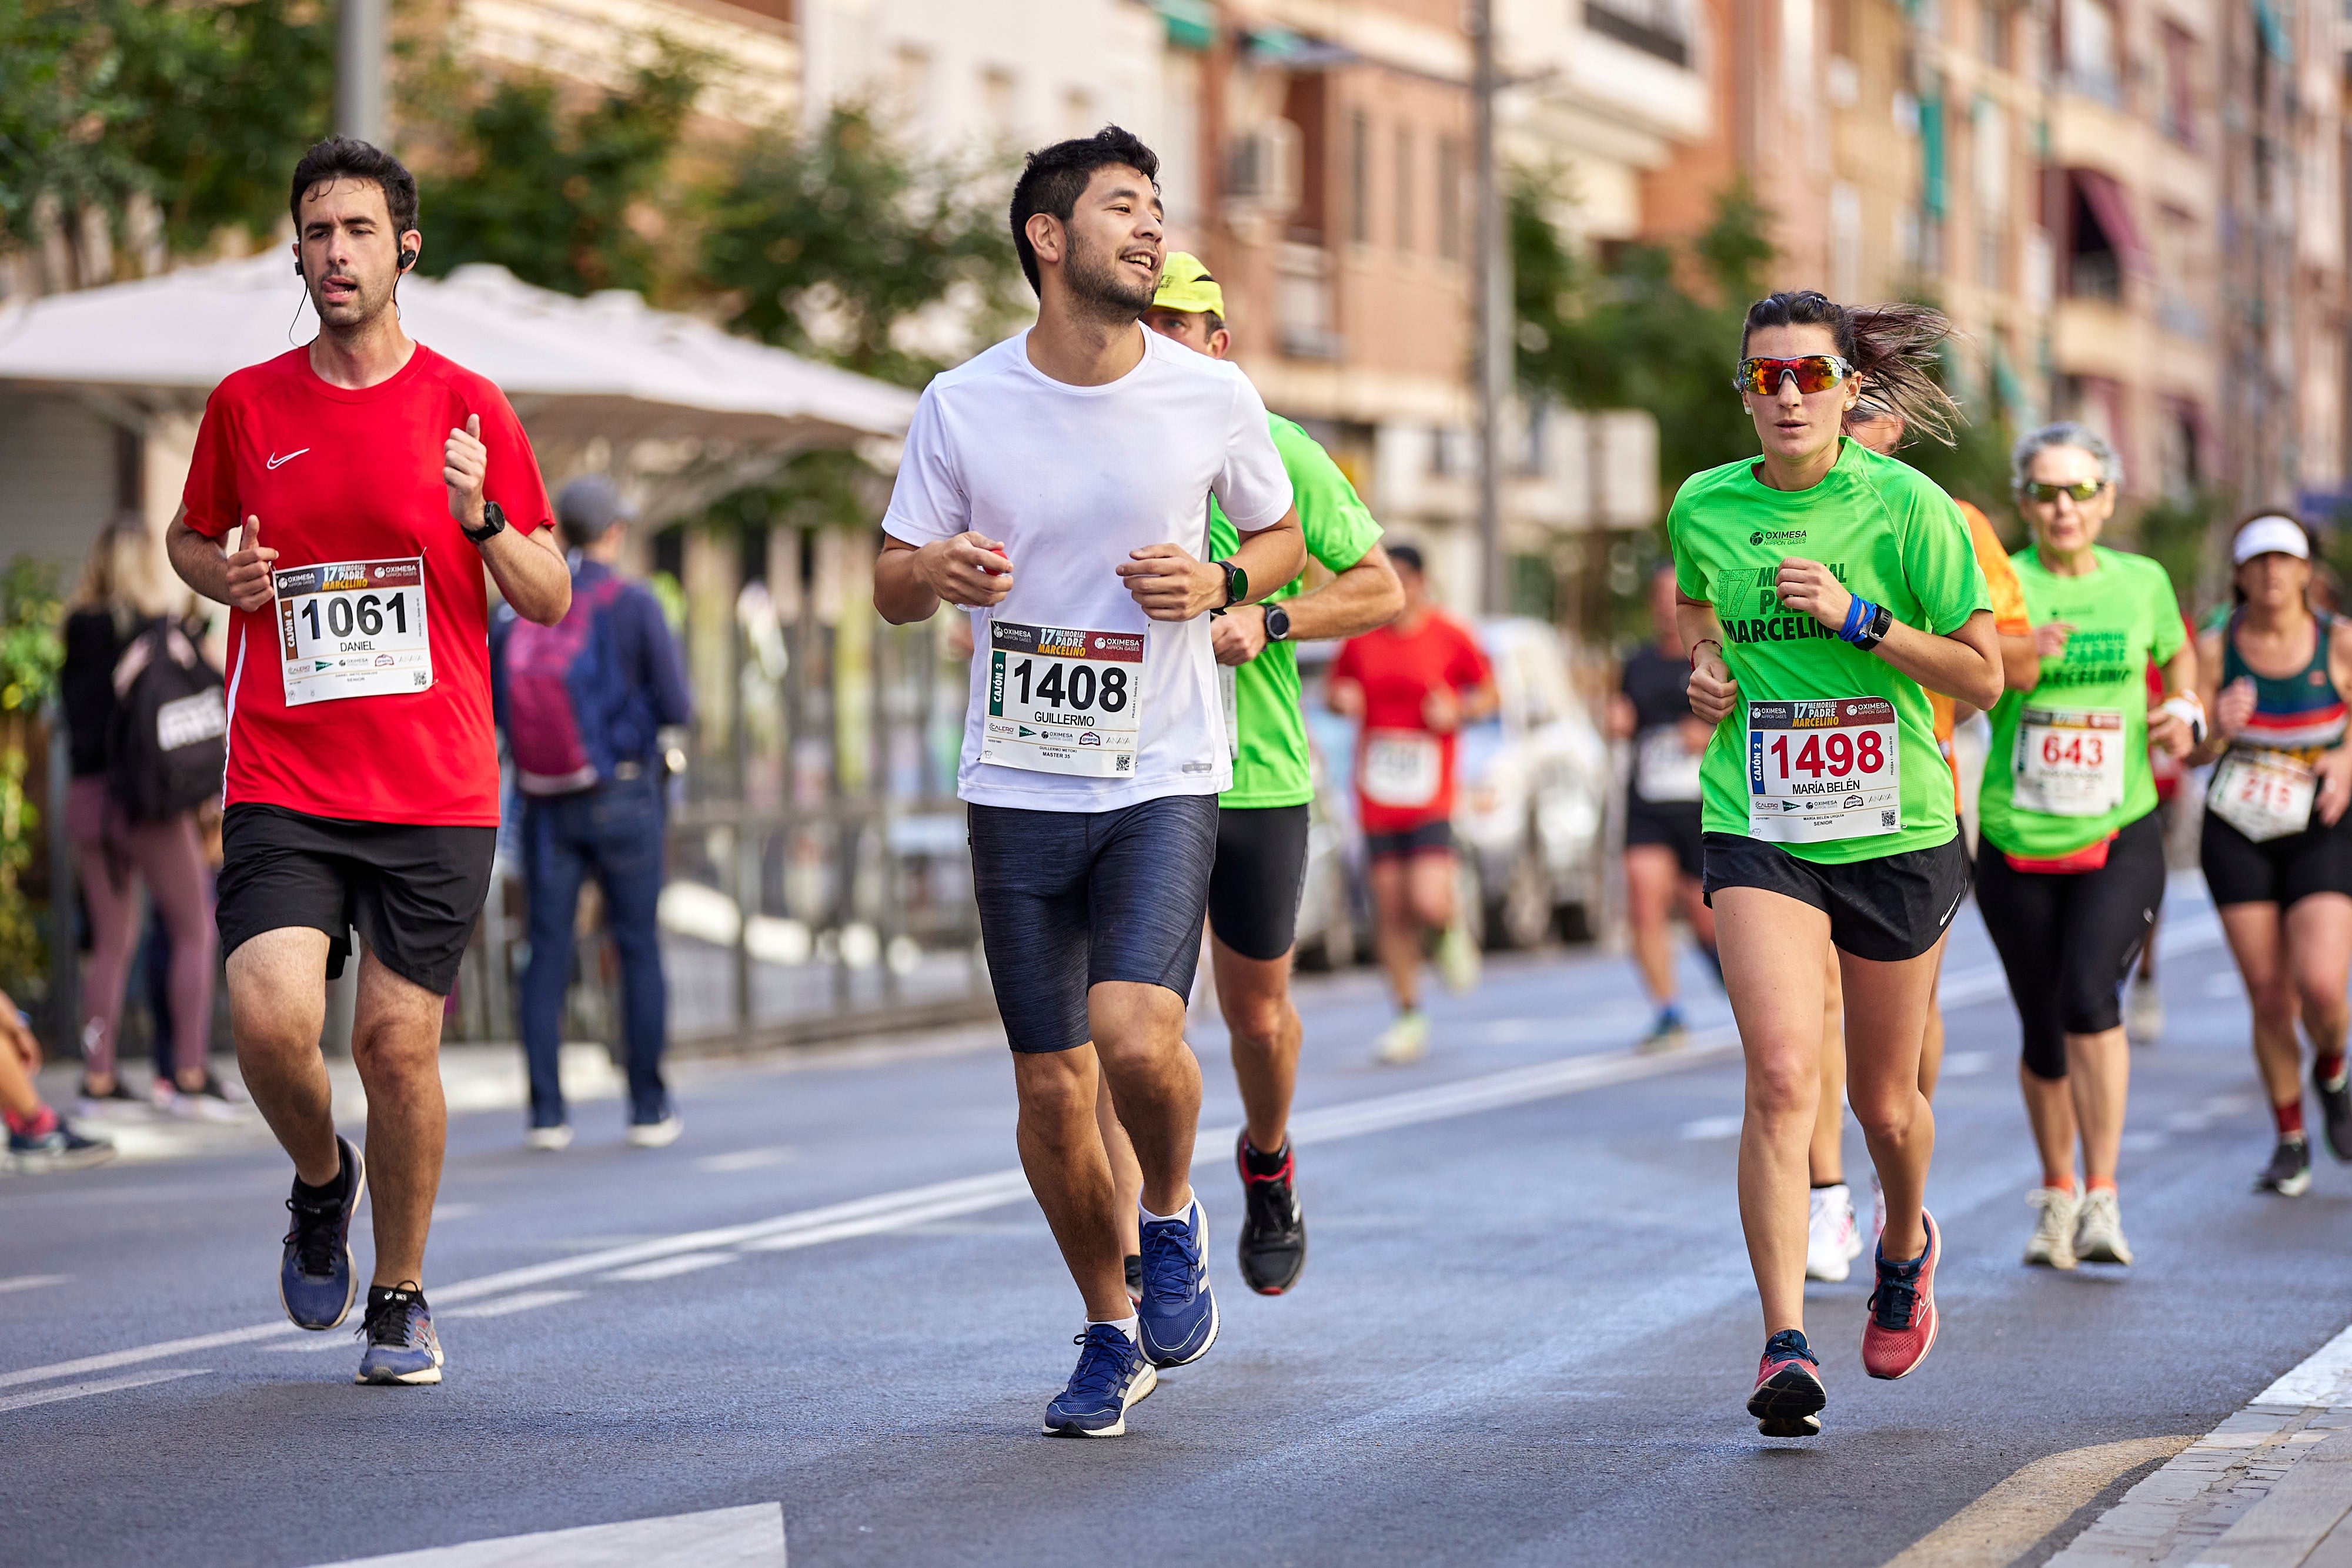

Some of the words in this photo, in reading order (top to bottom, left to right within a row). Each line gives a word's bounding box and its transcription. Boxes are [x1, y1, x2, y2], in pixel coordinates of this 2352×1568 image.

[1766, 530, 1806, 539] OXIMESA
[323, 566, 338, 582] 17
[338, 564, 366, 572] MEMORIAL
[385, 564, 417, 573] OXIMESA
[288, 573, 315, 583] OXIMESA
[339, 570, 365, 581] PADRE
[322, 578, 368, 591] MARCELINO
[1718, 569, 1759, 617] 17
[302, 592, 406, 640] 1061
[285, 619, 295, 647] CAJÓN
[1003, 628, 1031, 638] OXIMESA
[1721, 616, 1836, 643] MARCELIN
[1040, 628, 1057, 645] 17
[1055, 630, 1086, 638] MEMORIAL
[1055, 636, 1084, 647] PADRE
[1106, 638, 1140, 646] OXIMESA
[340, 641, 375, 652] DANIEL
[1037, 644, 1086, 657] MARCELINO
[993, 672, 1003, 703] CAJÓN
[1014, 658, 1127, 713] 1408
[1794, 703, 1808, 718] 17
[1858, 702, 1890, 710] OXIMESA
[1034, 711, 1095, 727] GUILLERMO
[1809, 708, 1836, 718] PADRE
[1792, 716, 1839, 727] MARCELINO
[991, 724, 1014, 733] CALERO
[1770, 730, 1884, 779] 1498
[2043, 735, 2103, 766] 643
[1792, 780, 1826, 794] MARÍA
[1827, 778, 1860, 793] BELÉN
[1868, 794, 1893, 803] ANAYA
